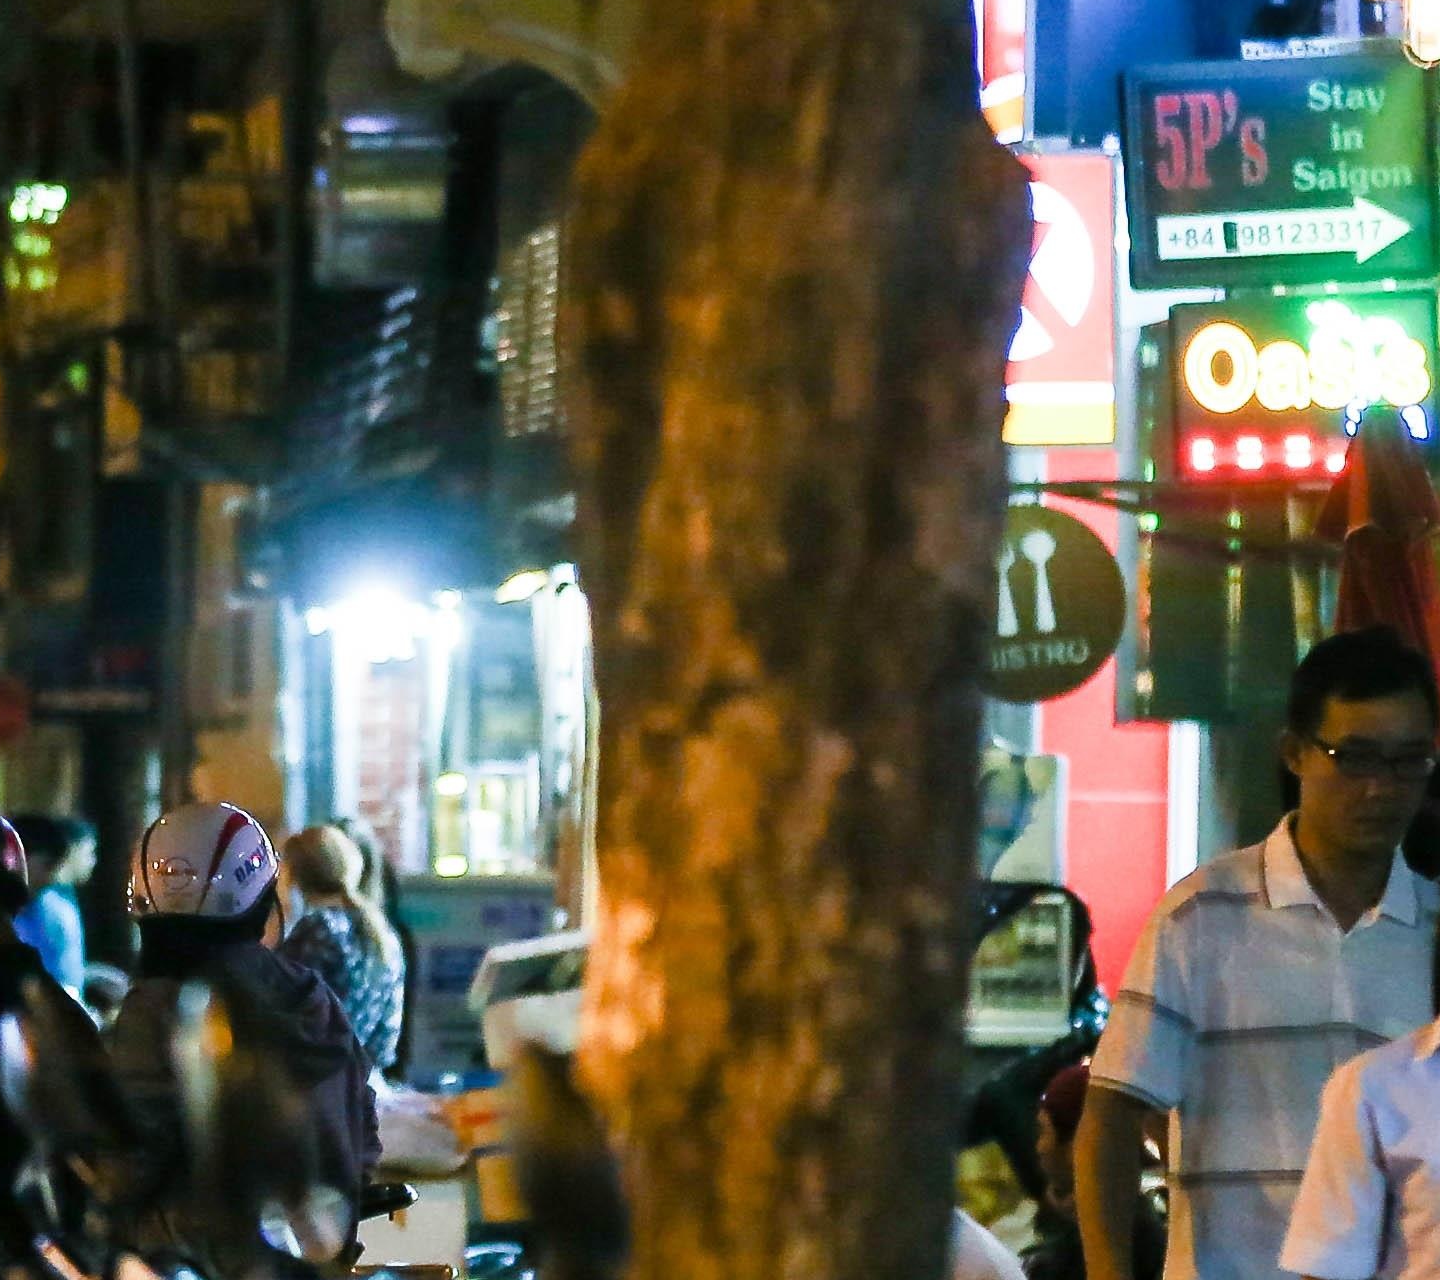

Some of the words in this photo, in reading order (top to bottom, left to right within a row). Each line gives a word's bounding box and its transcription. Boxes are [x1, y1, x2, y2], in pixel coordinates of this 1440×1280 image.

[1306, 79, 1386, 115] Stay
[1154, 89, 1269, 191] 5P's
[1328, 120, 1364, 152] in
[1291, 157, 1413, 195] Saigon
[1168, 225, 1216, 248] +84
